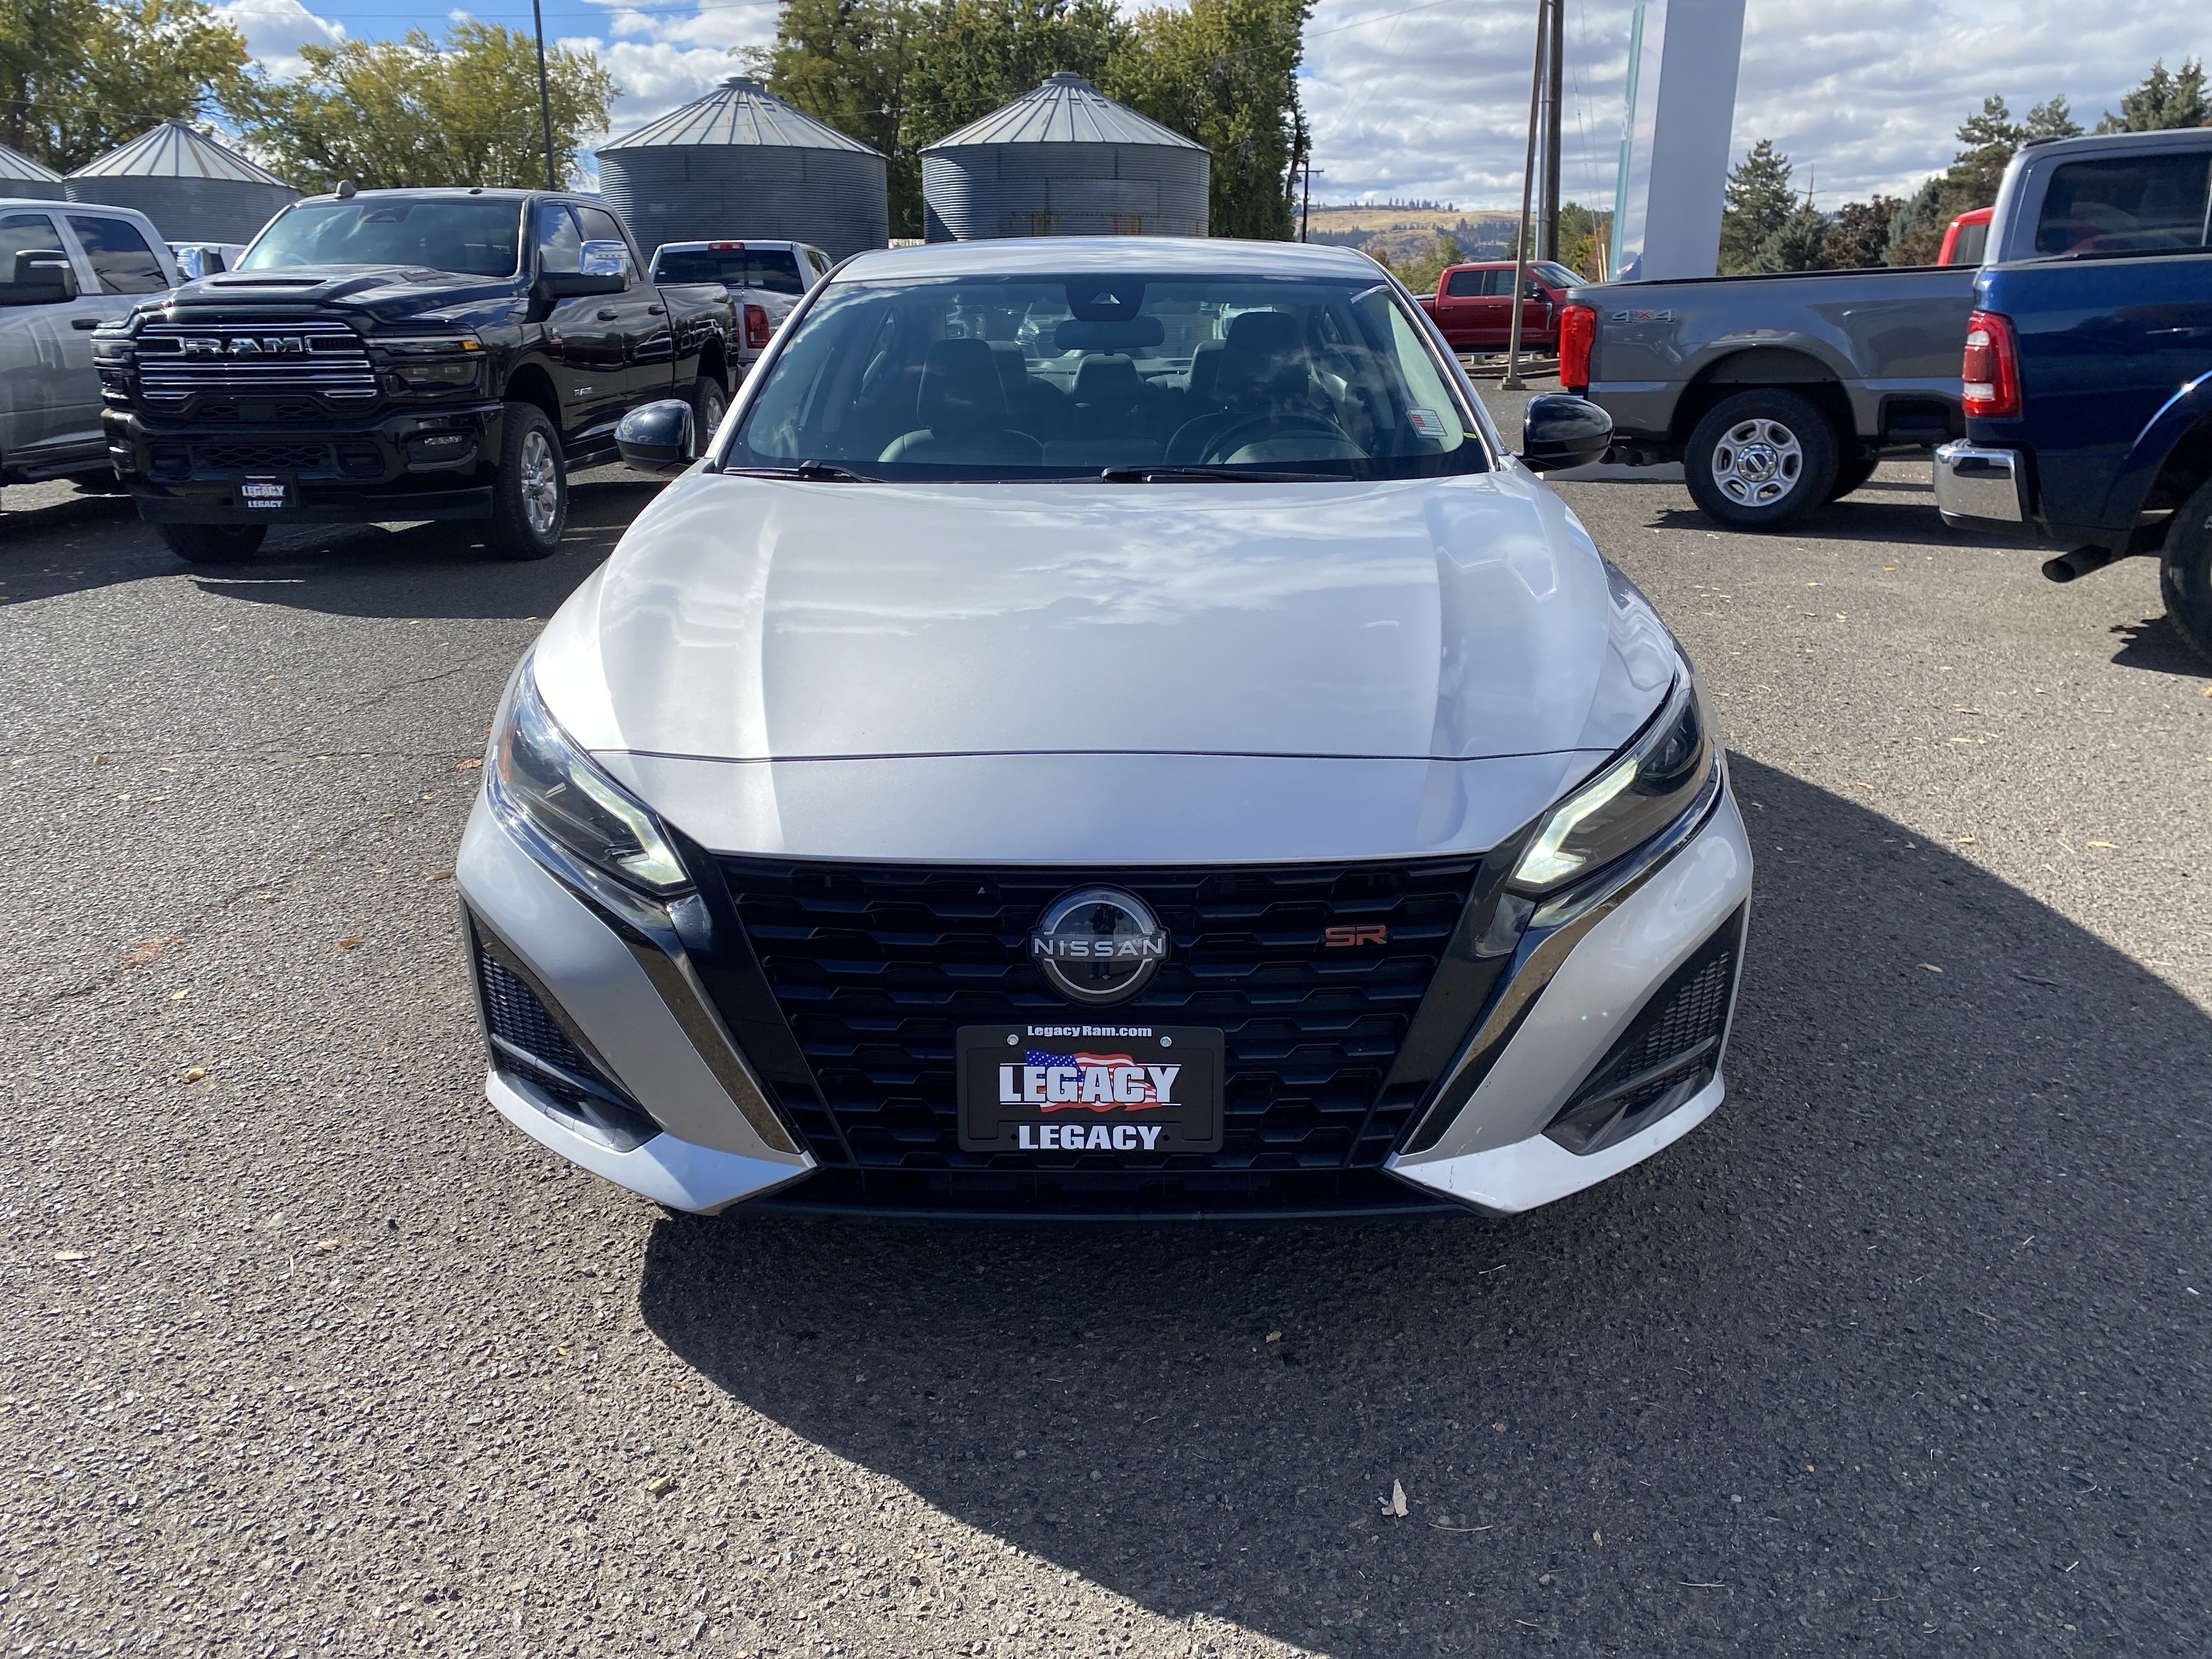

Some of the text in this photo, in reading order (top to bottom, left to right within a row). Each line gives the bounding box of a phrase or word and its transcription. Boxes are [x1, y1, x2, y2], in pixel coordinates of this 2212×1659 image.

[185, 336, 304, 354] RAM
[241, 486, 284, 496] LEGACY
[1325, 925, 1387, 947] SR
[1034, 938, 1163, 957] NISSAN
[999, 1065, 1181, 1103] LEGACY
[1019, 1125, 1162, 1150] LEGACY
